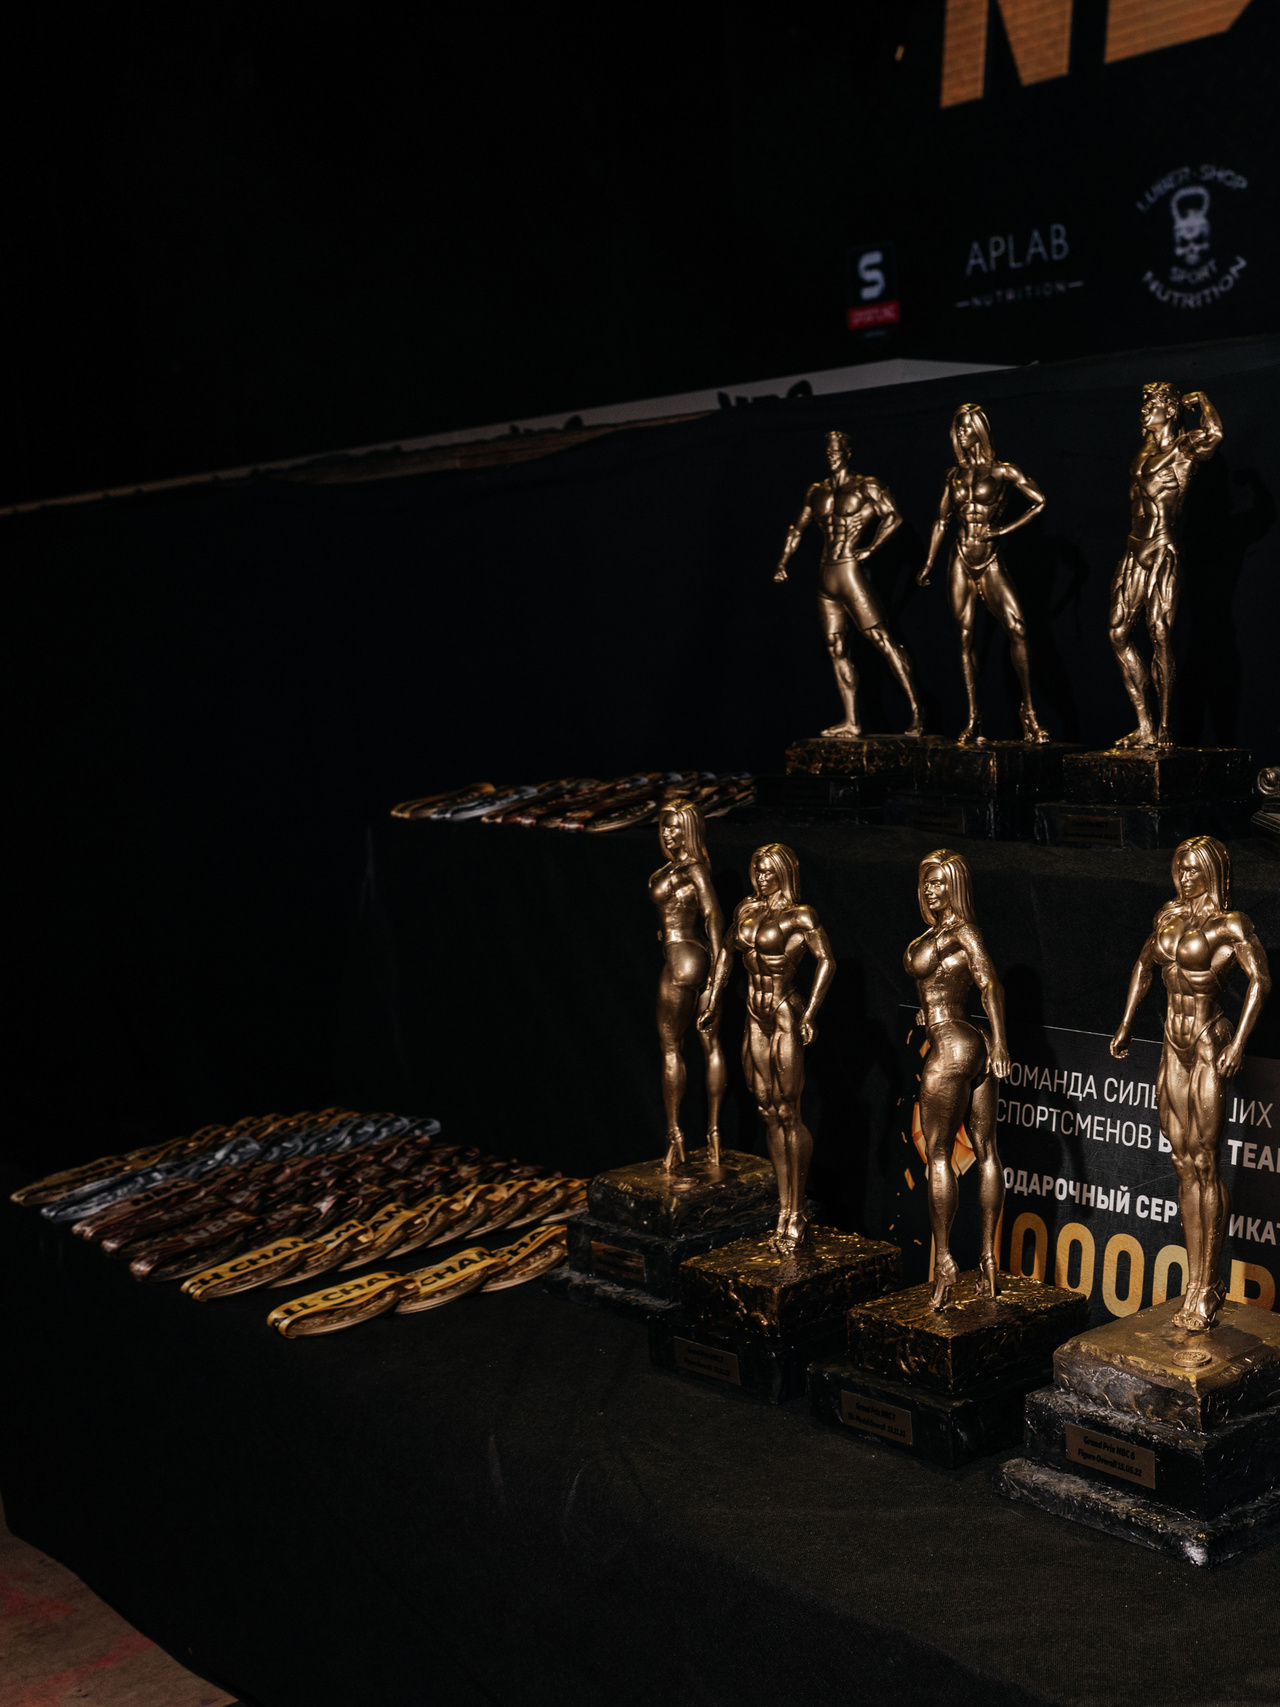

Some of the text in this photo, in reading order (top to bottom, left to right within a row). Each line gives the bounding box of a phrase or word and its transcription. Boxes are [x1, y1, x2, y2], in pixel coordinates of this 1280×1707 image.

[965, 223, 1071, 277] APLAB
[1142, 255, 1248, 309] NUTRITION
[998, 1062, 1098, 1102] ОМАНДА
[996, 1098, 1153, 1150] СПОРТСМЕНОВ
[1003, 1166, 1132, 1216] ОДАРОЧНЫЙ
[183, 1210, 247, 1244] NBC
[1078, 1448, 1142, 1478] Figure Overall 15.05.22
[1083, 1436, 1136, 1460] Grand Prix NBC 6
